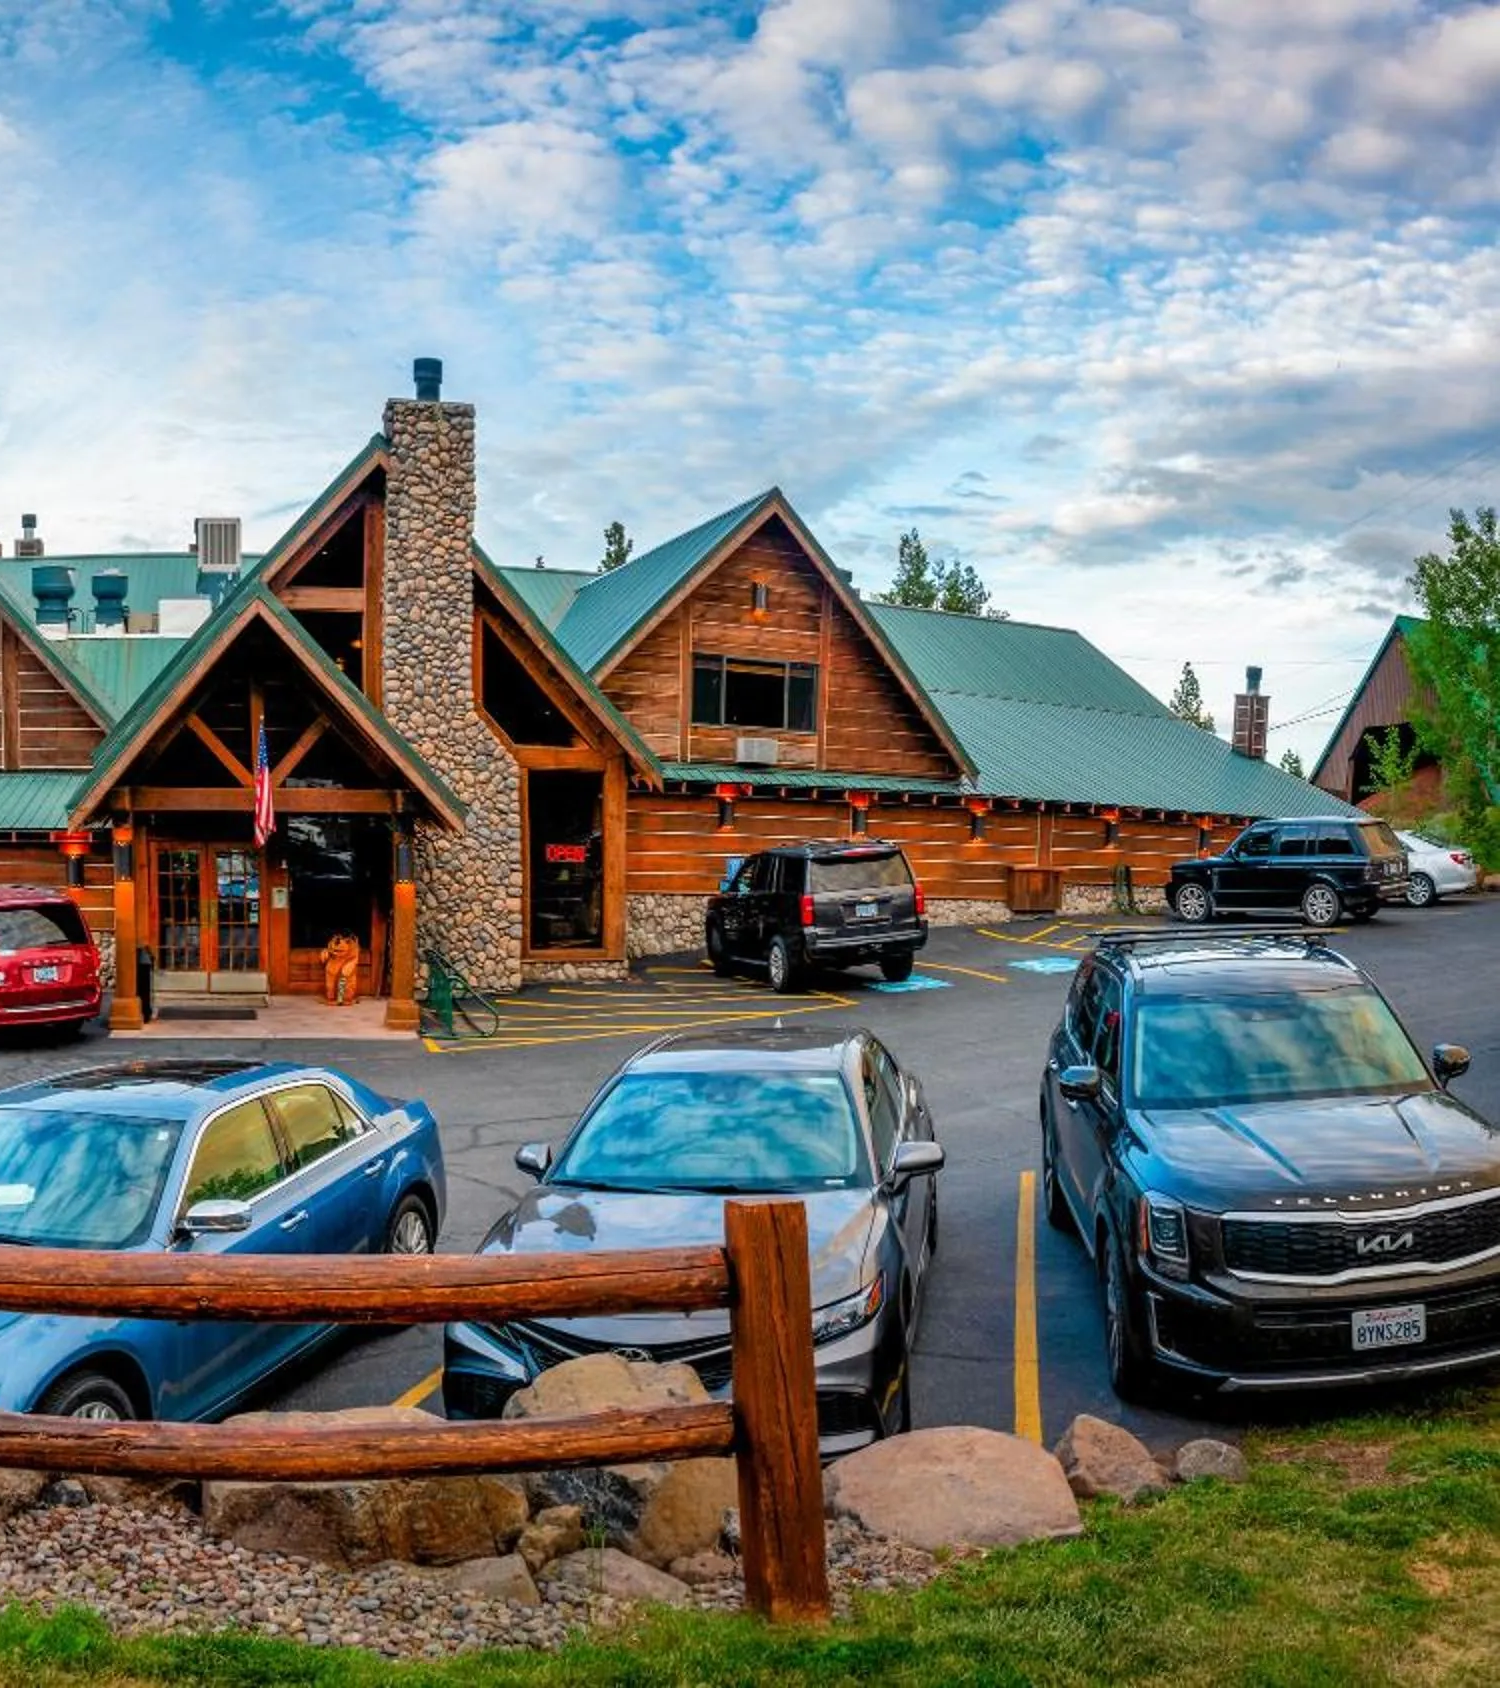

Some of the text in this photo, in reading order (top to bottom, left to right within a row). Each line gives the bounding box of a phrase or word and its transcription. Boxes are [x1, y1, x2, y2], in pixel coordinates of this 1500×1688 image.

[546, 844, 586, 863] OPEN
[1357, 1232, 1414, 1254] KIA
[1357, 1320, 1421, 1344] 8YNS285
